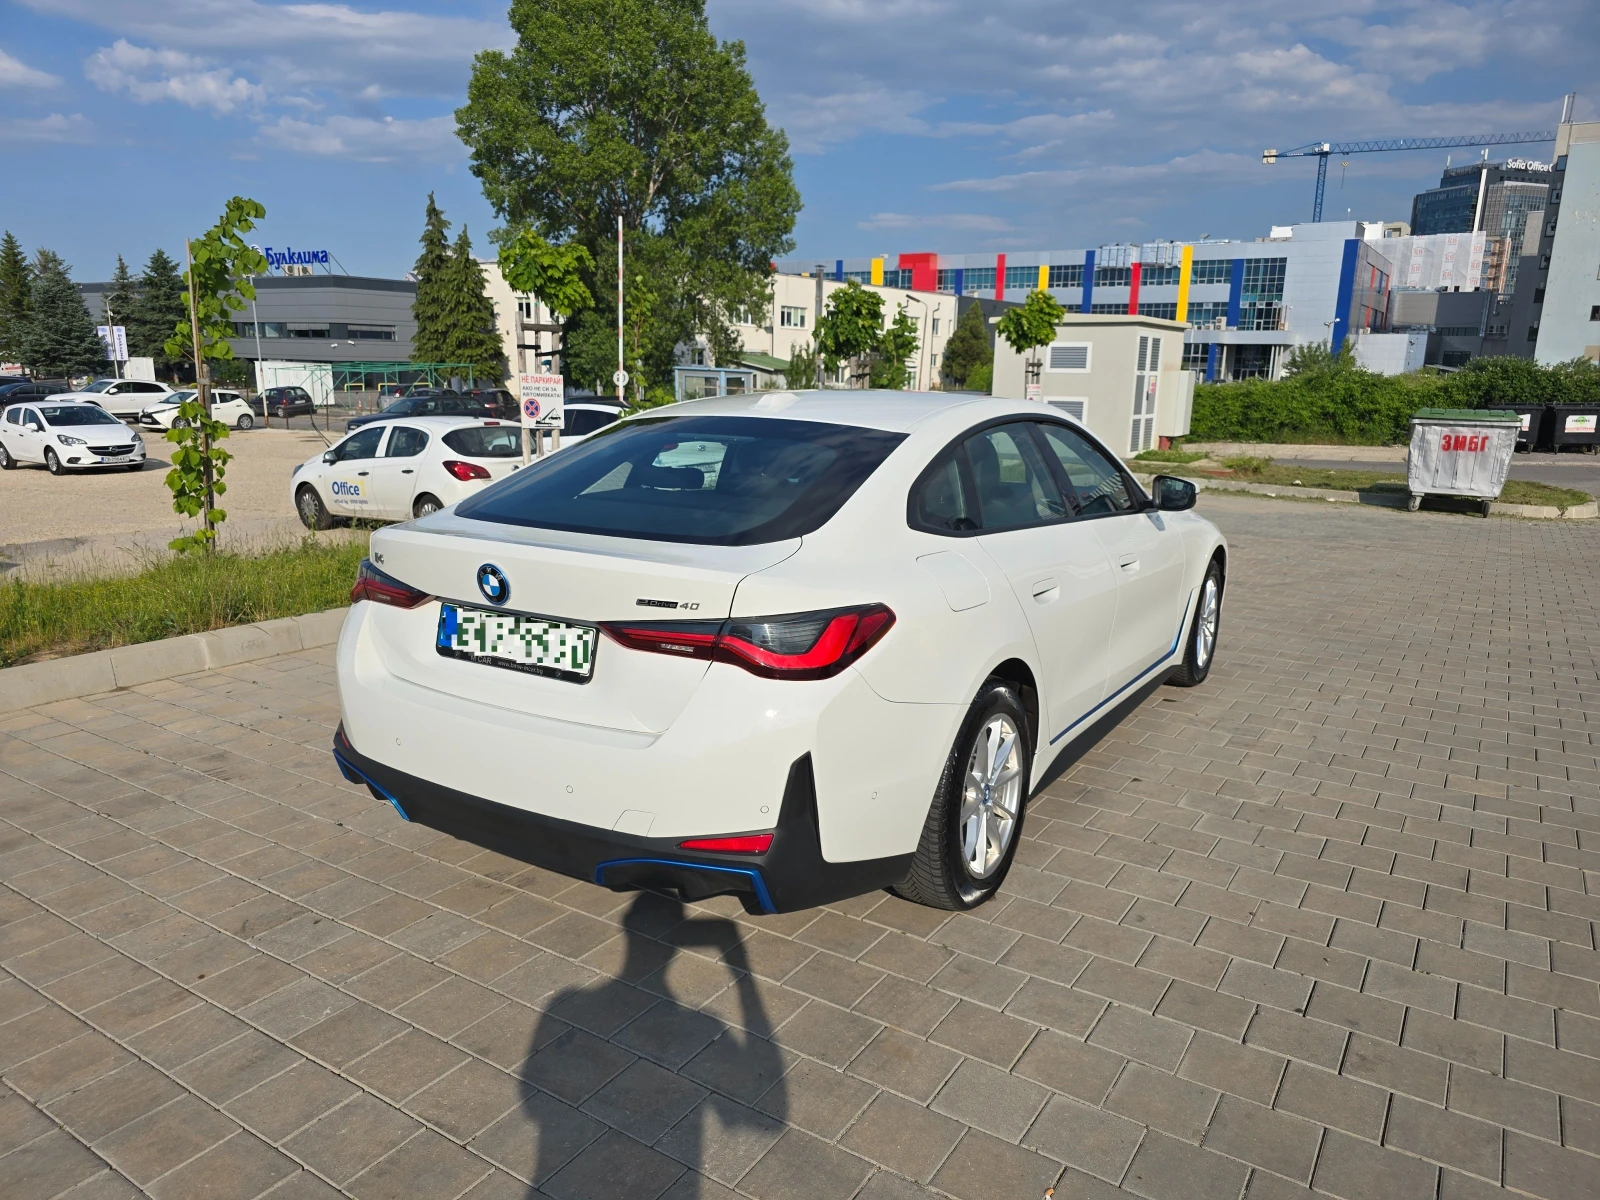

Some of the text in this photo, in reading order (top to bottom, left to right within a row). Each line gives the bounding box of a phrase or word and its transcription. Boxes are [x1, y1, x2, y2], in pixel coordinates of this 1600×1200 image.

[1507, 159, 1526, 170] Sofia
[1527, 160, 1548, 171] Office
[264, 247, 329, 270] Булклима
[521, 375, 562, 385] НЕ ПАРКИРАЙ!
[1441, 434, 1490, 452] ЗМБГ
[332, 481, 360, 496] Office
[679, 602, 700, 611] 40
[477, 656, 492, 665] CAR
